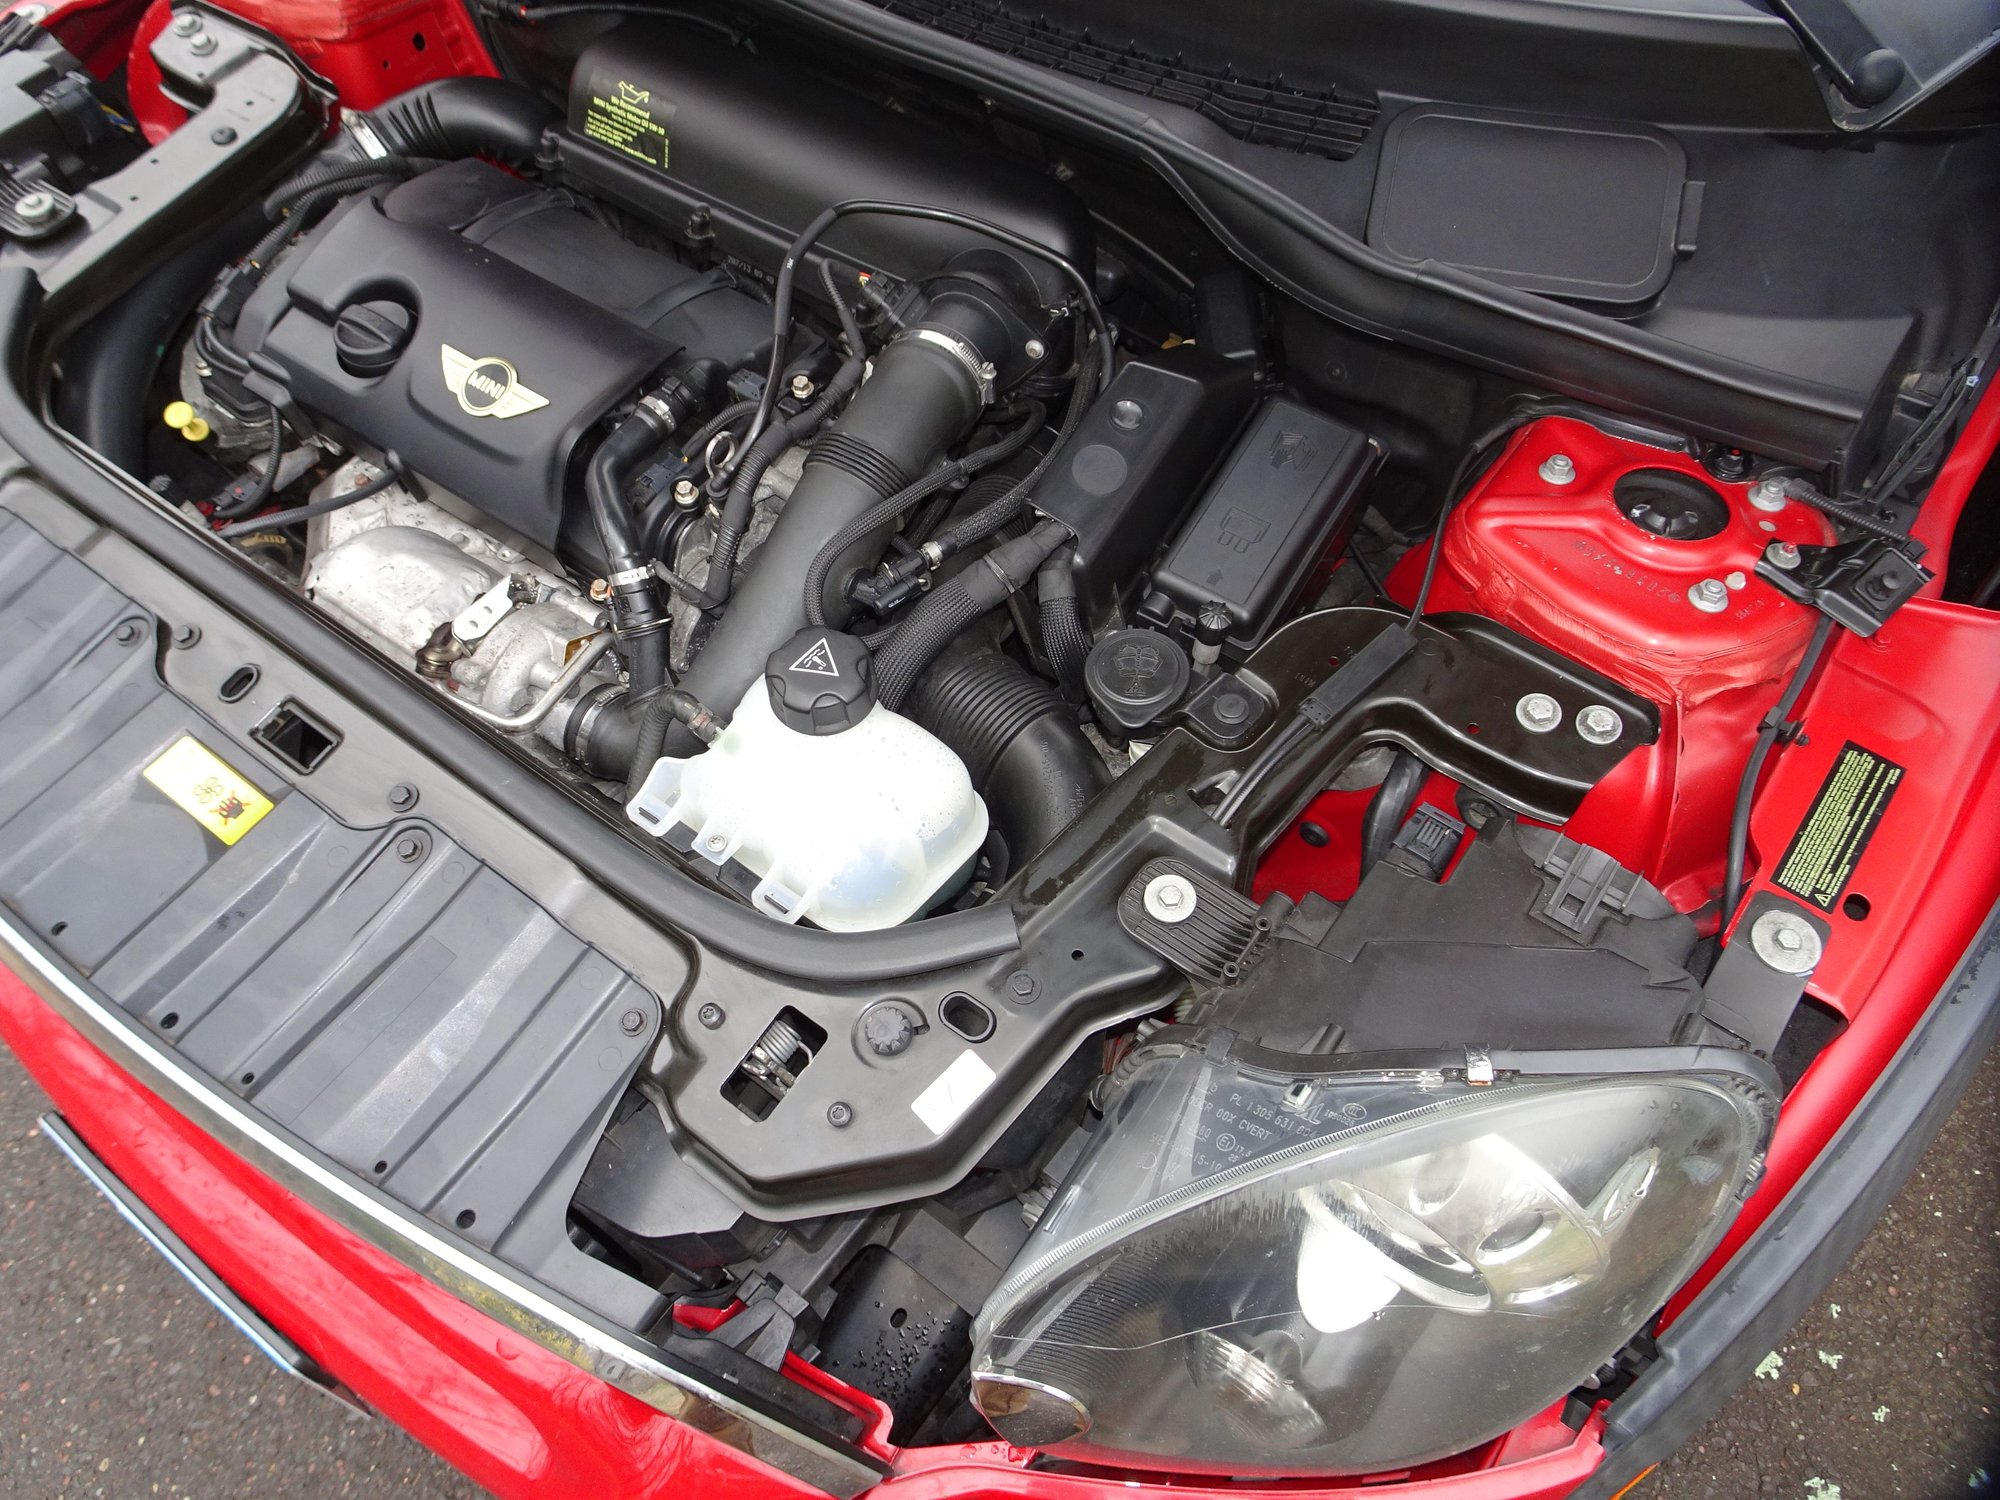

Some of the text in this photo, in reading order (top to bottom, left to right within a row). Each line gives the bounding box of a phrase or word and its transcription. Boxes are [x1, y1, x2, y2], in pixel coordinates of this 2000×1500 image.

[467, 371, 506, 400] MINI
[1229, 1093, 1242, 1107] PL
[1274, 1115, 1294, 1130] 631
[1238, 1119, 1272, 1141] CVERT
